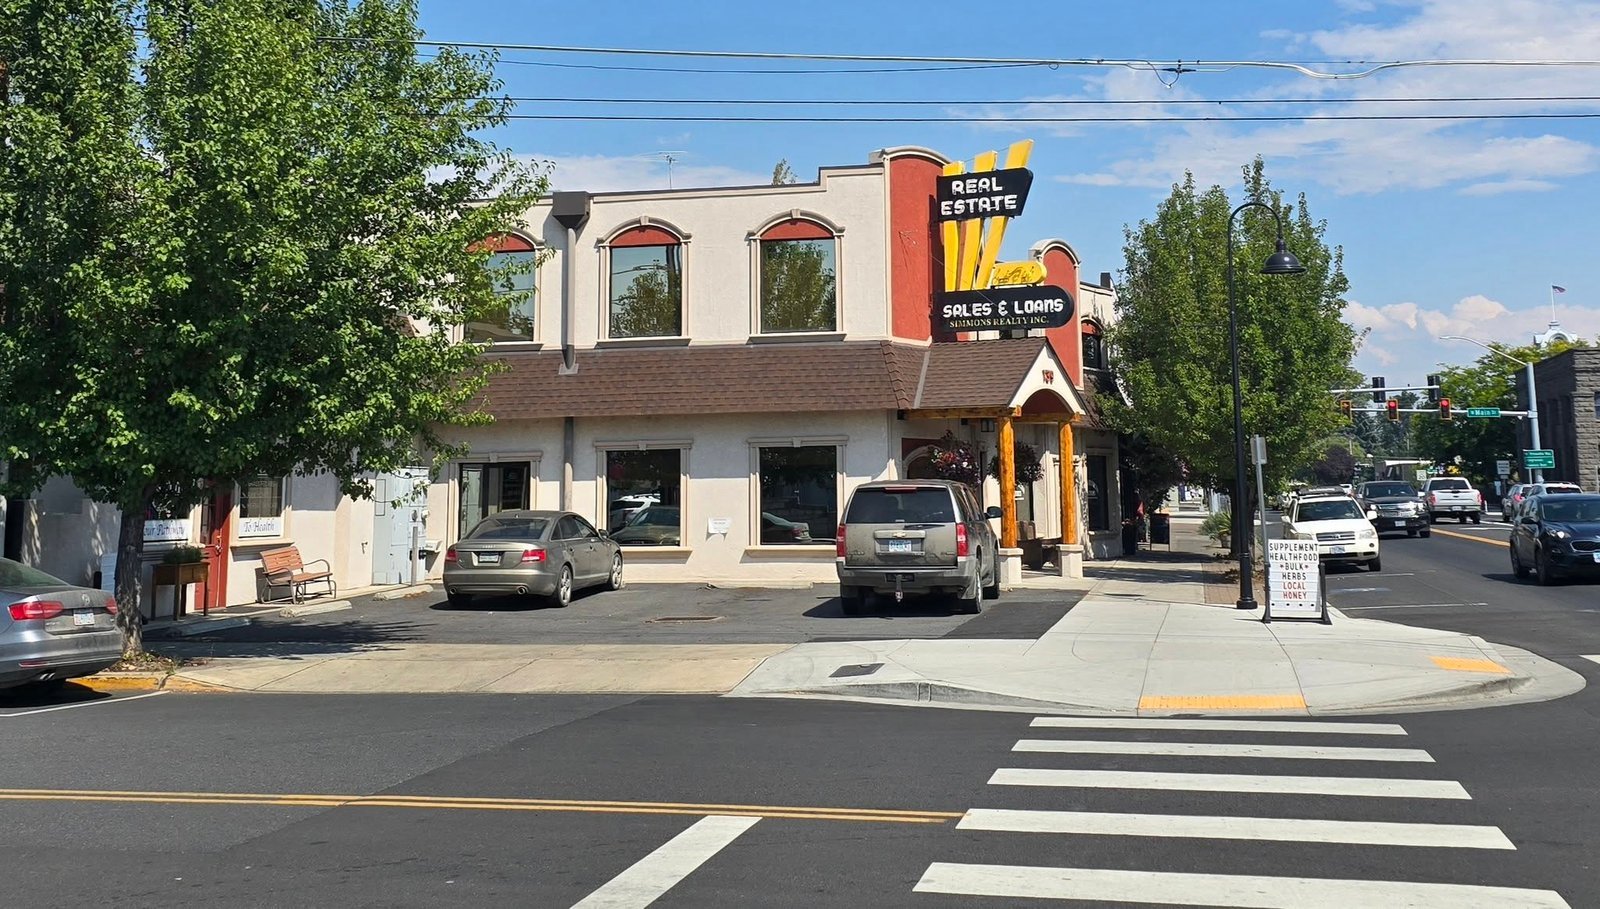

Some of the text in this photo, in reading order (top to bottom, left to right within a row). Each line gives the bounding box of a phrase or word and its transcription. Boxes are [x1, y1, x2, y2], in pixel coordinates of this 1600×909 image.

[951, 177, 1003, 195] REAL
[940, 194, 1018, 216] ESTATE
[942, 298, 1064, 318] SALES & LOANS
[949, 315, 1050, 328] SIMMONS REALTY INC.
[244, 519, 275, 533] To Health
[1269, 542, 1318, 552] SUPPLEMENT
[1269, 552, 1318, 561] HEALTHFOOD
[1284, 562, 1304, 571] BULK
[1281, 572, 1307, 581] HERBS
[1283, 581, 1306, 590] LOCAL
[1283, 591, 1307, 600] HONEY
